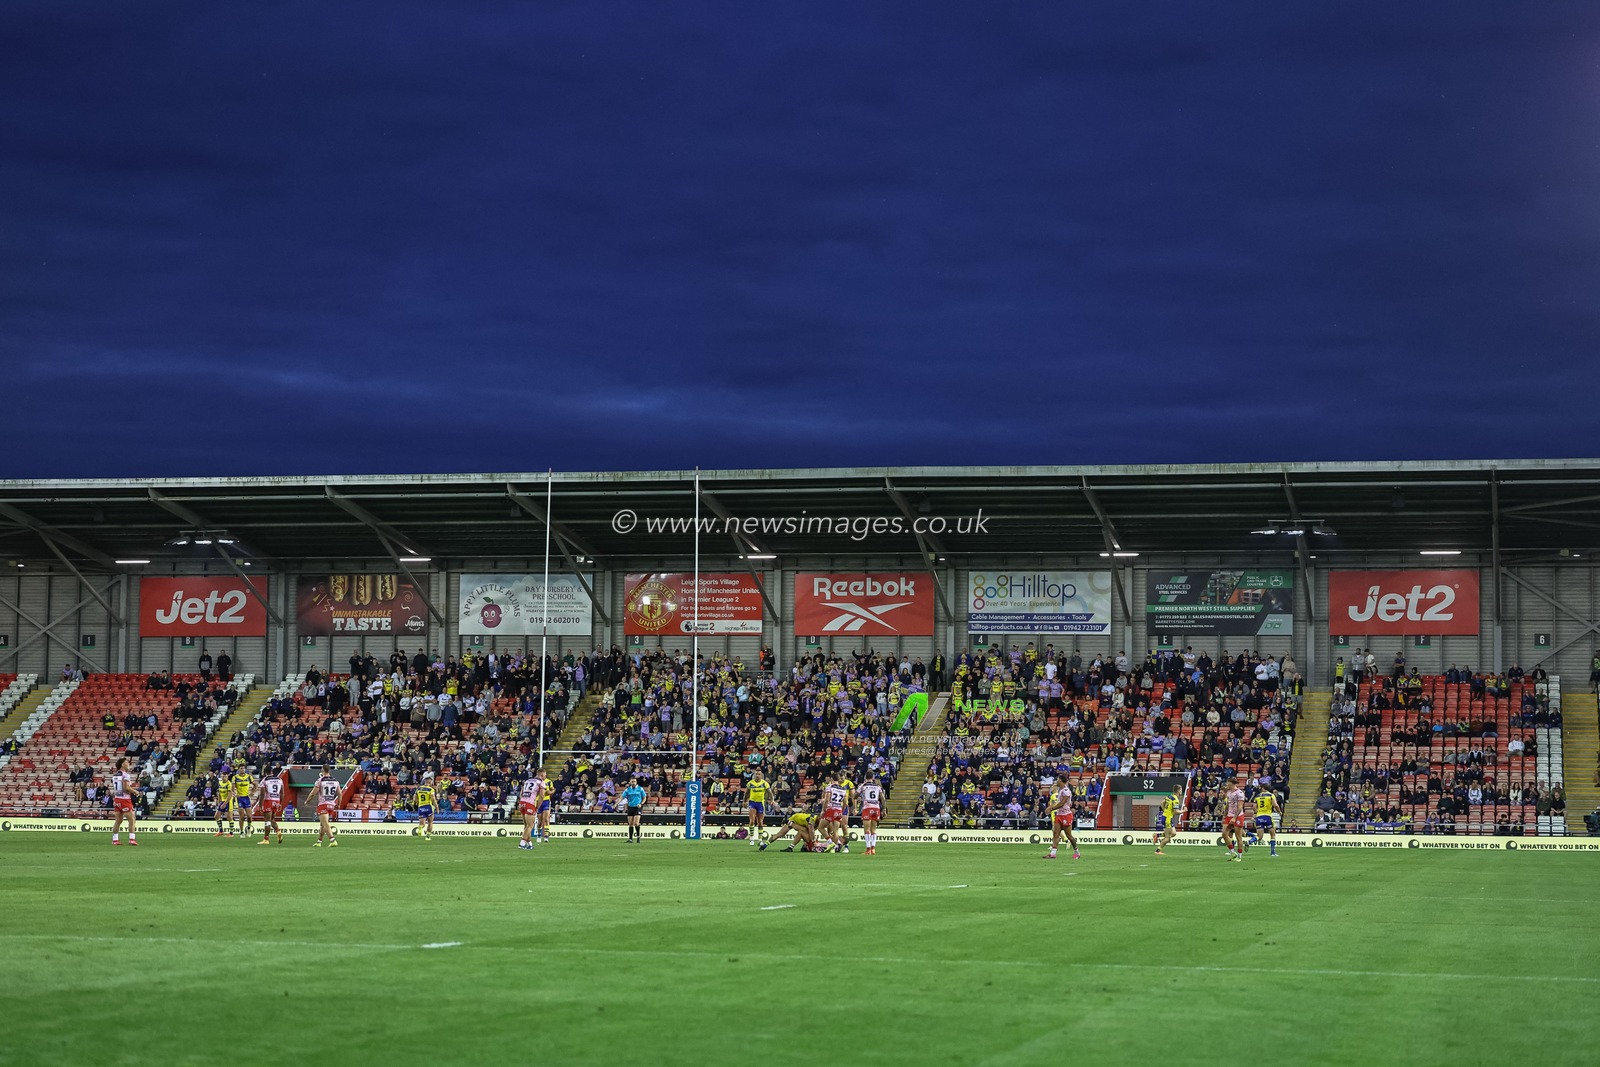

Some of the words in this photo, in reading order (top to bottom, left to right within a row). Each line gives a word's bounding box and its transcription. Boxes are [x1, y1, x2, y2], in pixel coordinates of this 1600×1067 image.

[525, 585, 541, 593] DAY
[633, 581, 673, 599] MANCHESTER
[813, 577, 915, 600] Reebok
[1009, 574, 1077, 607] Hilltop
[476, 583, 504, 595] LITTLE
[505, 591, 521, 617] PLUMS
[332, 610, 392, 618] UNMISTAKABLE
[333, 617, 392, 631] TASTE
[638, 618, 667, 628] UNITED
[709, 622, 715, 631] 2
[185, 636, 191, 644] B
[307, 636, 312, 645] 2
[474, 635, 480, 644] C
[634, 635, 640, 644] 3
[810, 635, 816, 644] D
[978, 635, 983, 644] 4
[1163, 635, 1168, 644] E
[1338, 635, 1344, 644] 5
[1420, 635, 1425, 644] F
[1539, 635, 1545, 645] 6
[272, 784, 279, 793] 9
[1143, 779, 1155, 790] S2
[323, 786, 337, 797] 16
[869, 790, 876, 800] 6
[420, 793, 426, 802] 9
[831, 792, 844, 803] 22
[1259, 800, 1265, 809] 3
[690, 795, 698, 838] BETFRED
